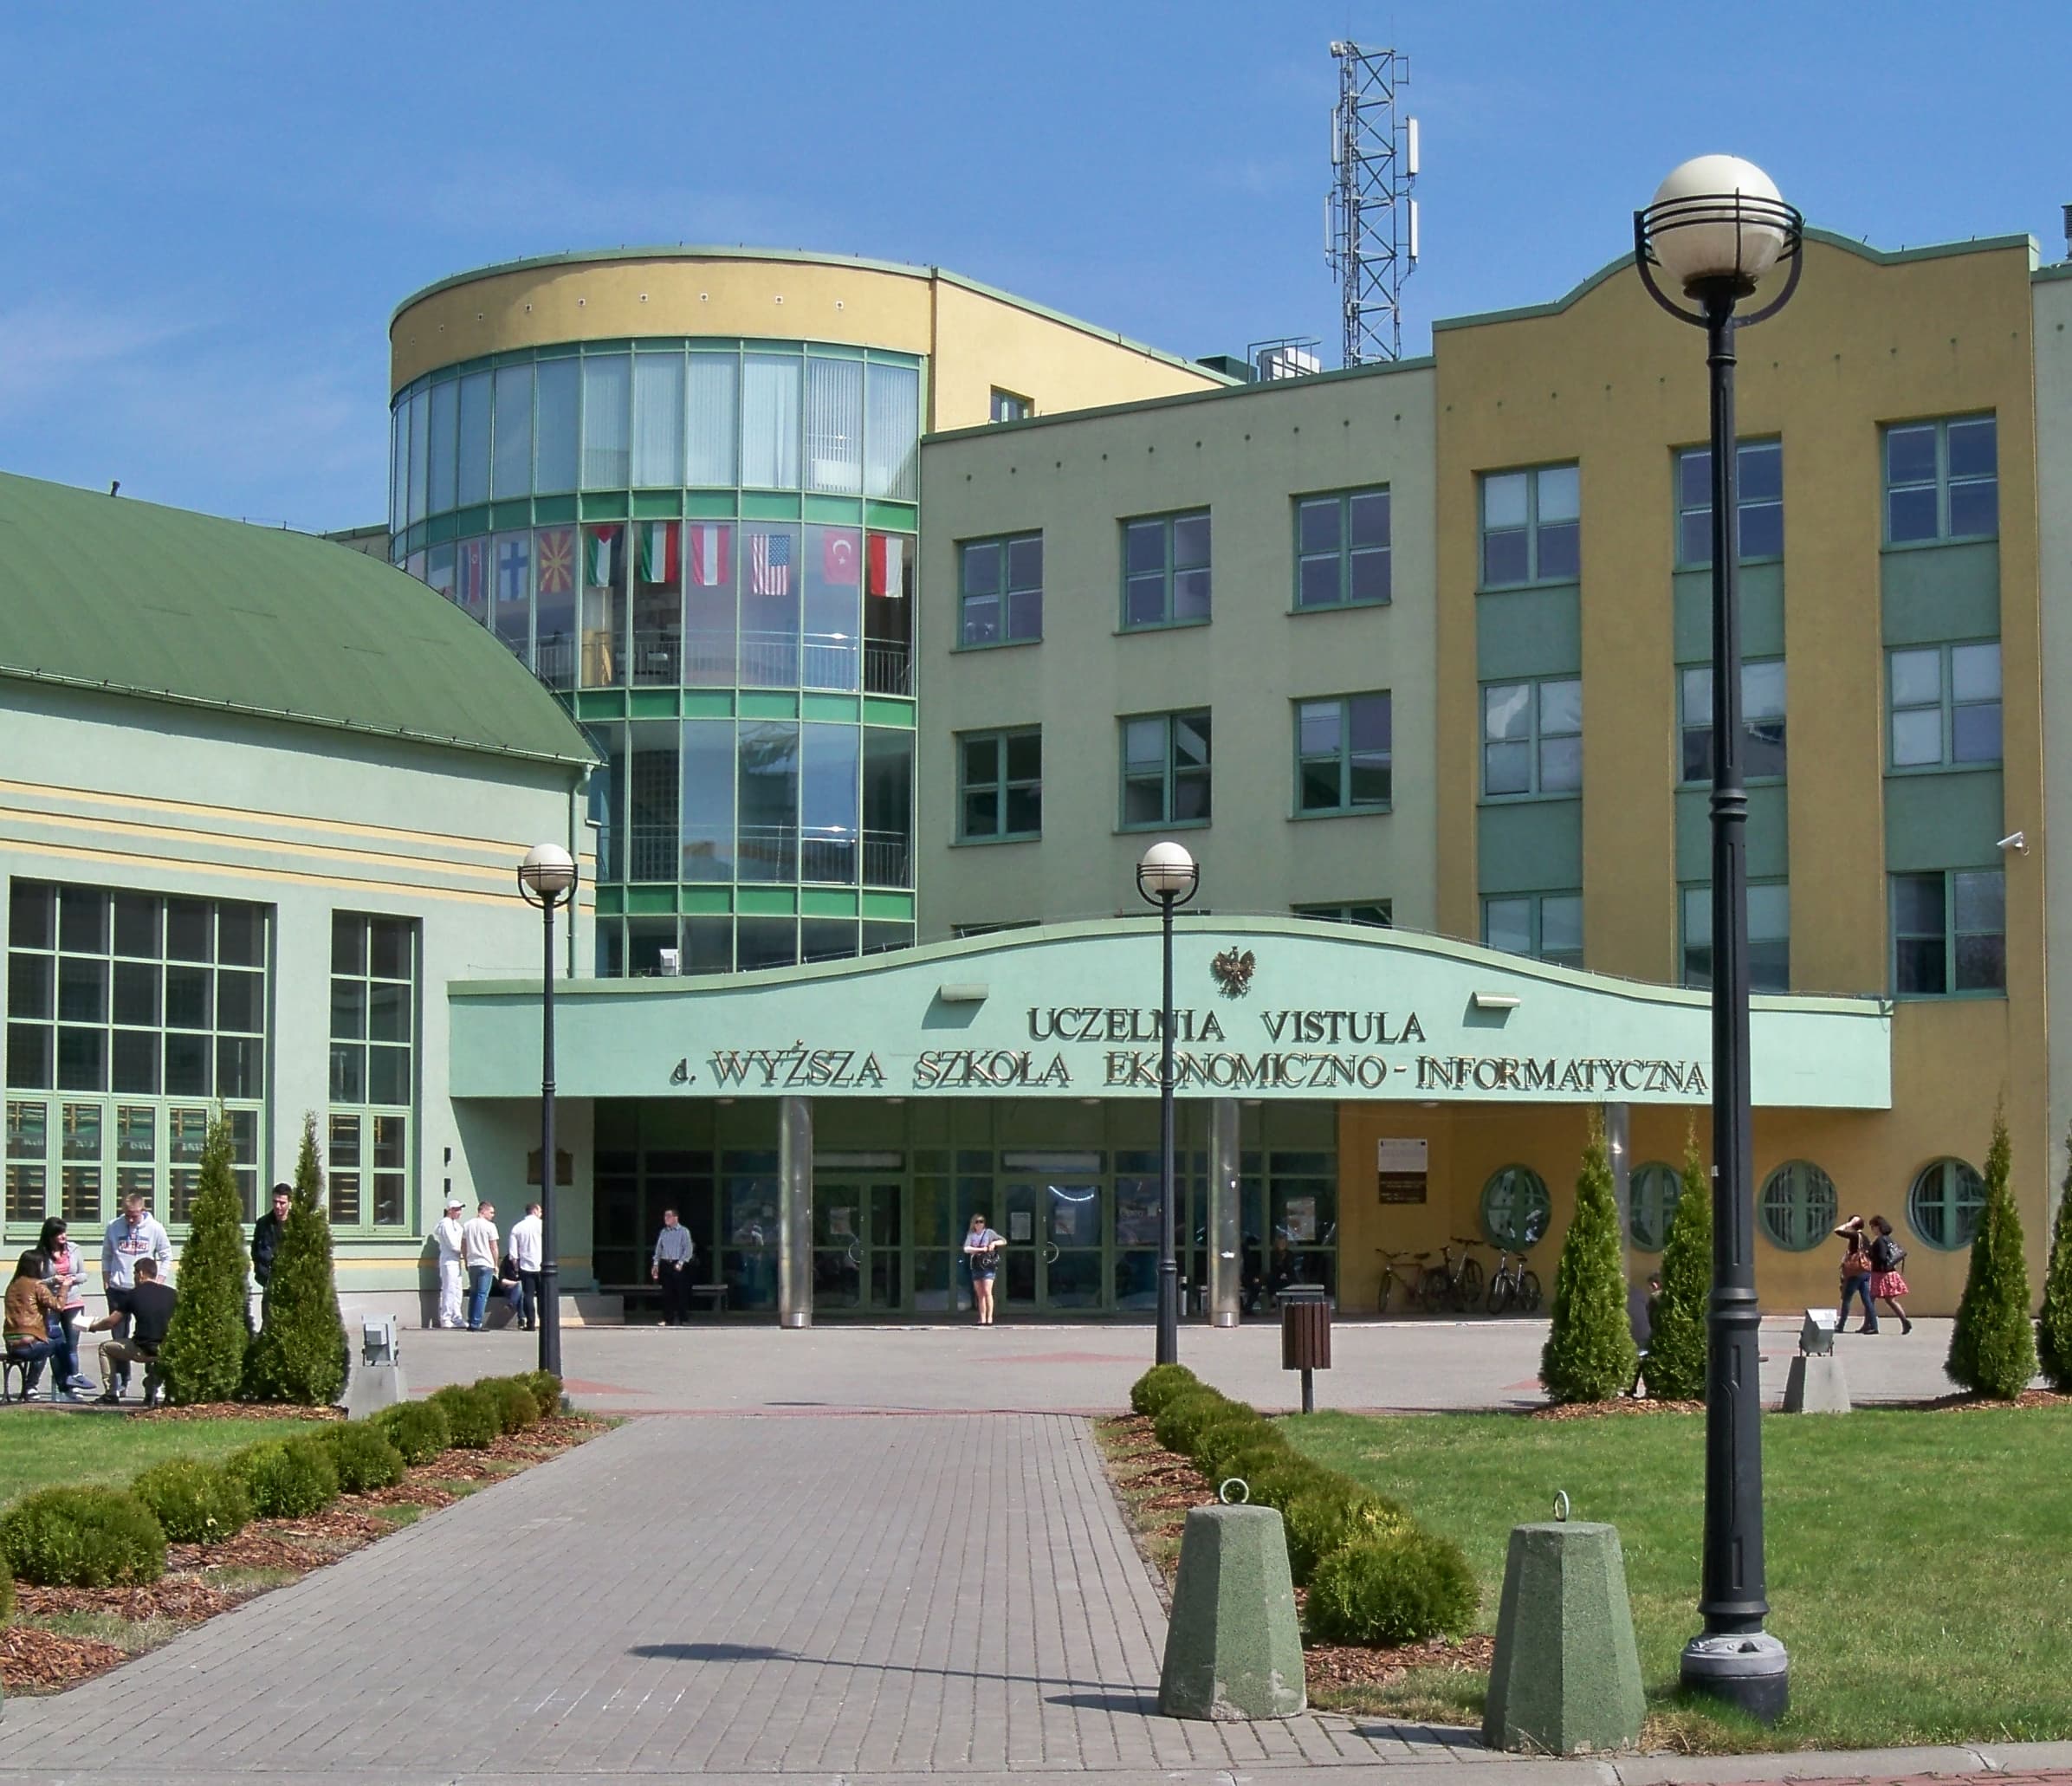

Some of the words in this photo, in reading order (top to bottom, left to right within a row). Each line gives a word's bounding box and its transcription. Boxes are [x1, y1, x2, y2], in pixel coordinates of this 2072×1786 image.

[1028, 1006, 1227, 1042] UCZELNIA
[1261, 1010, 1426, 1044] VISTULA
[710, 1039, 888, 1085] WYŻSZA
[917, 1050, 1074, 1086] SZKOŁA
